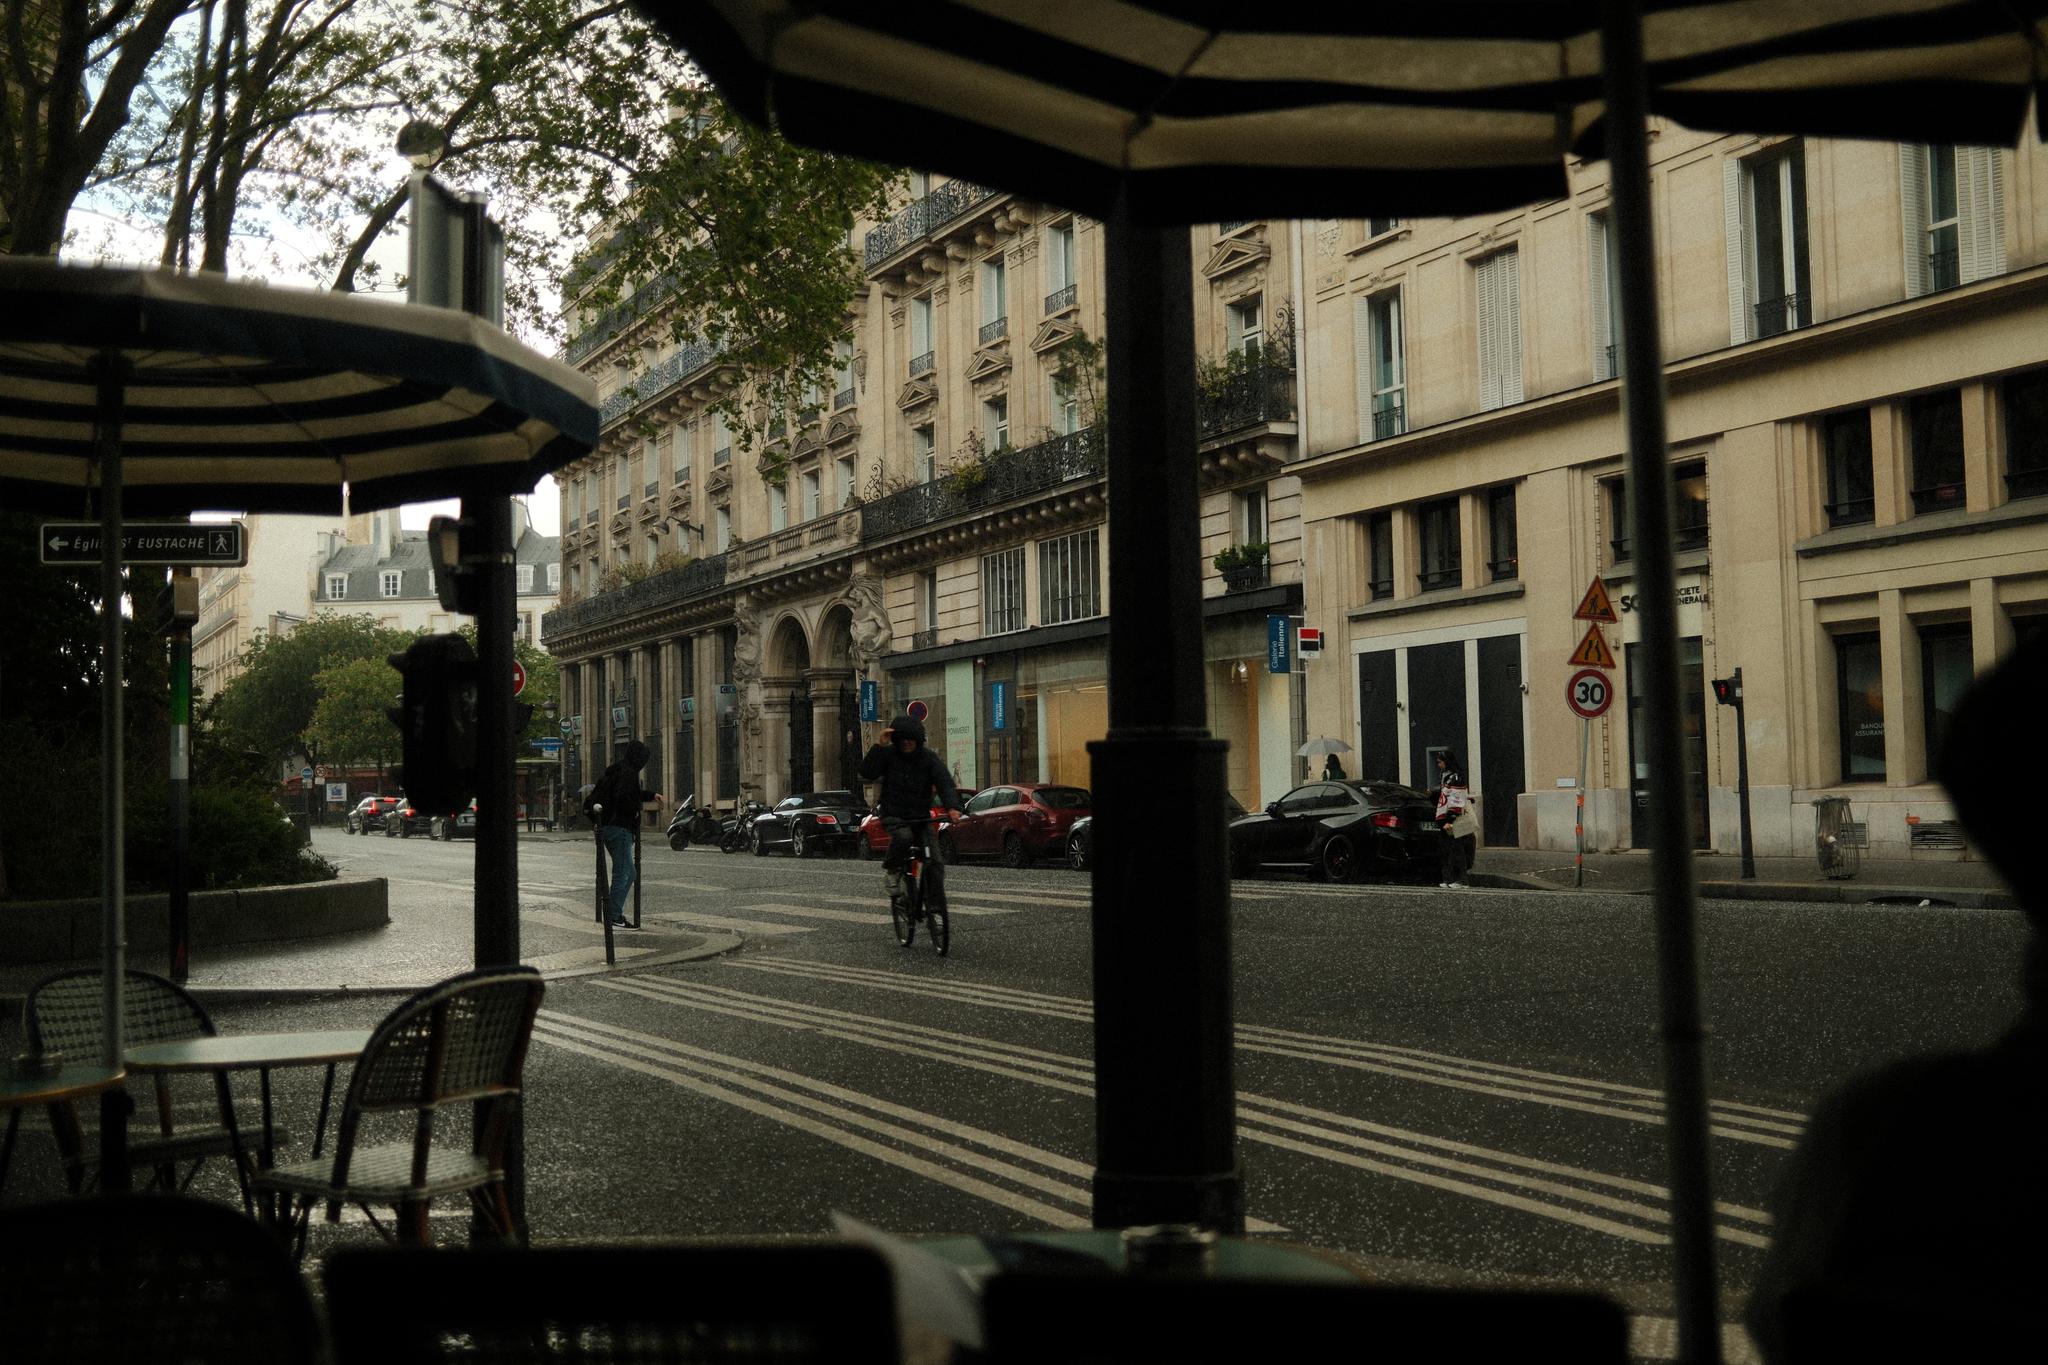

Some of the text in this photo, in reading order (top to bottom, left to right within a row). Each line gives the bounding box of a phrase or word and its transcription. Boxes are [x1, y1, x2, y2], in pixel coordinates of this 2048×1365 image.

[73, 536, 103, 551] Égli
[138, 537, 205, 549] EUSTACHE
[1675, 586, 1700, 596] OCIETE
[1675, 593, 1709, 606] NERALE
[1576, 682, 1605, 705] 30
[1860, 722, 1883, 730] BANQU
